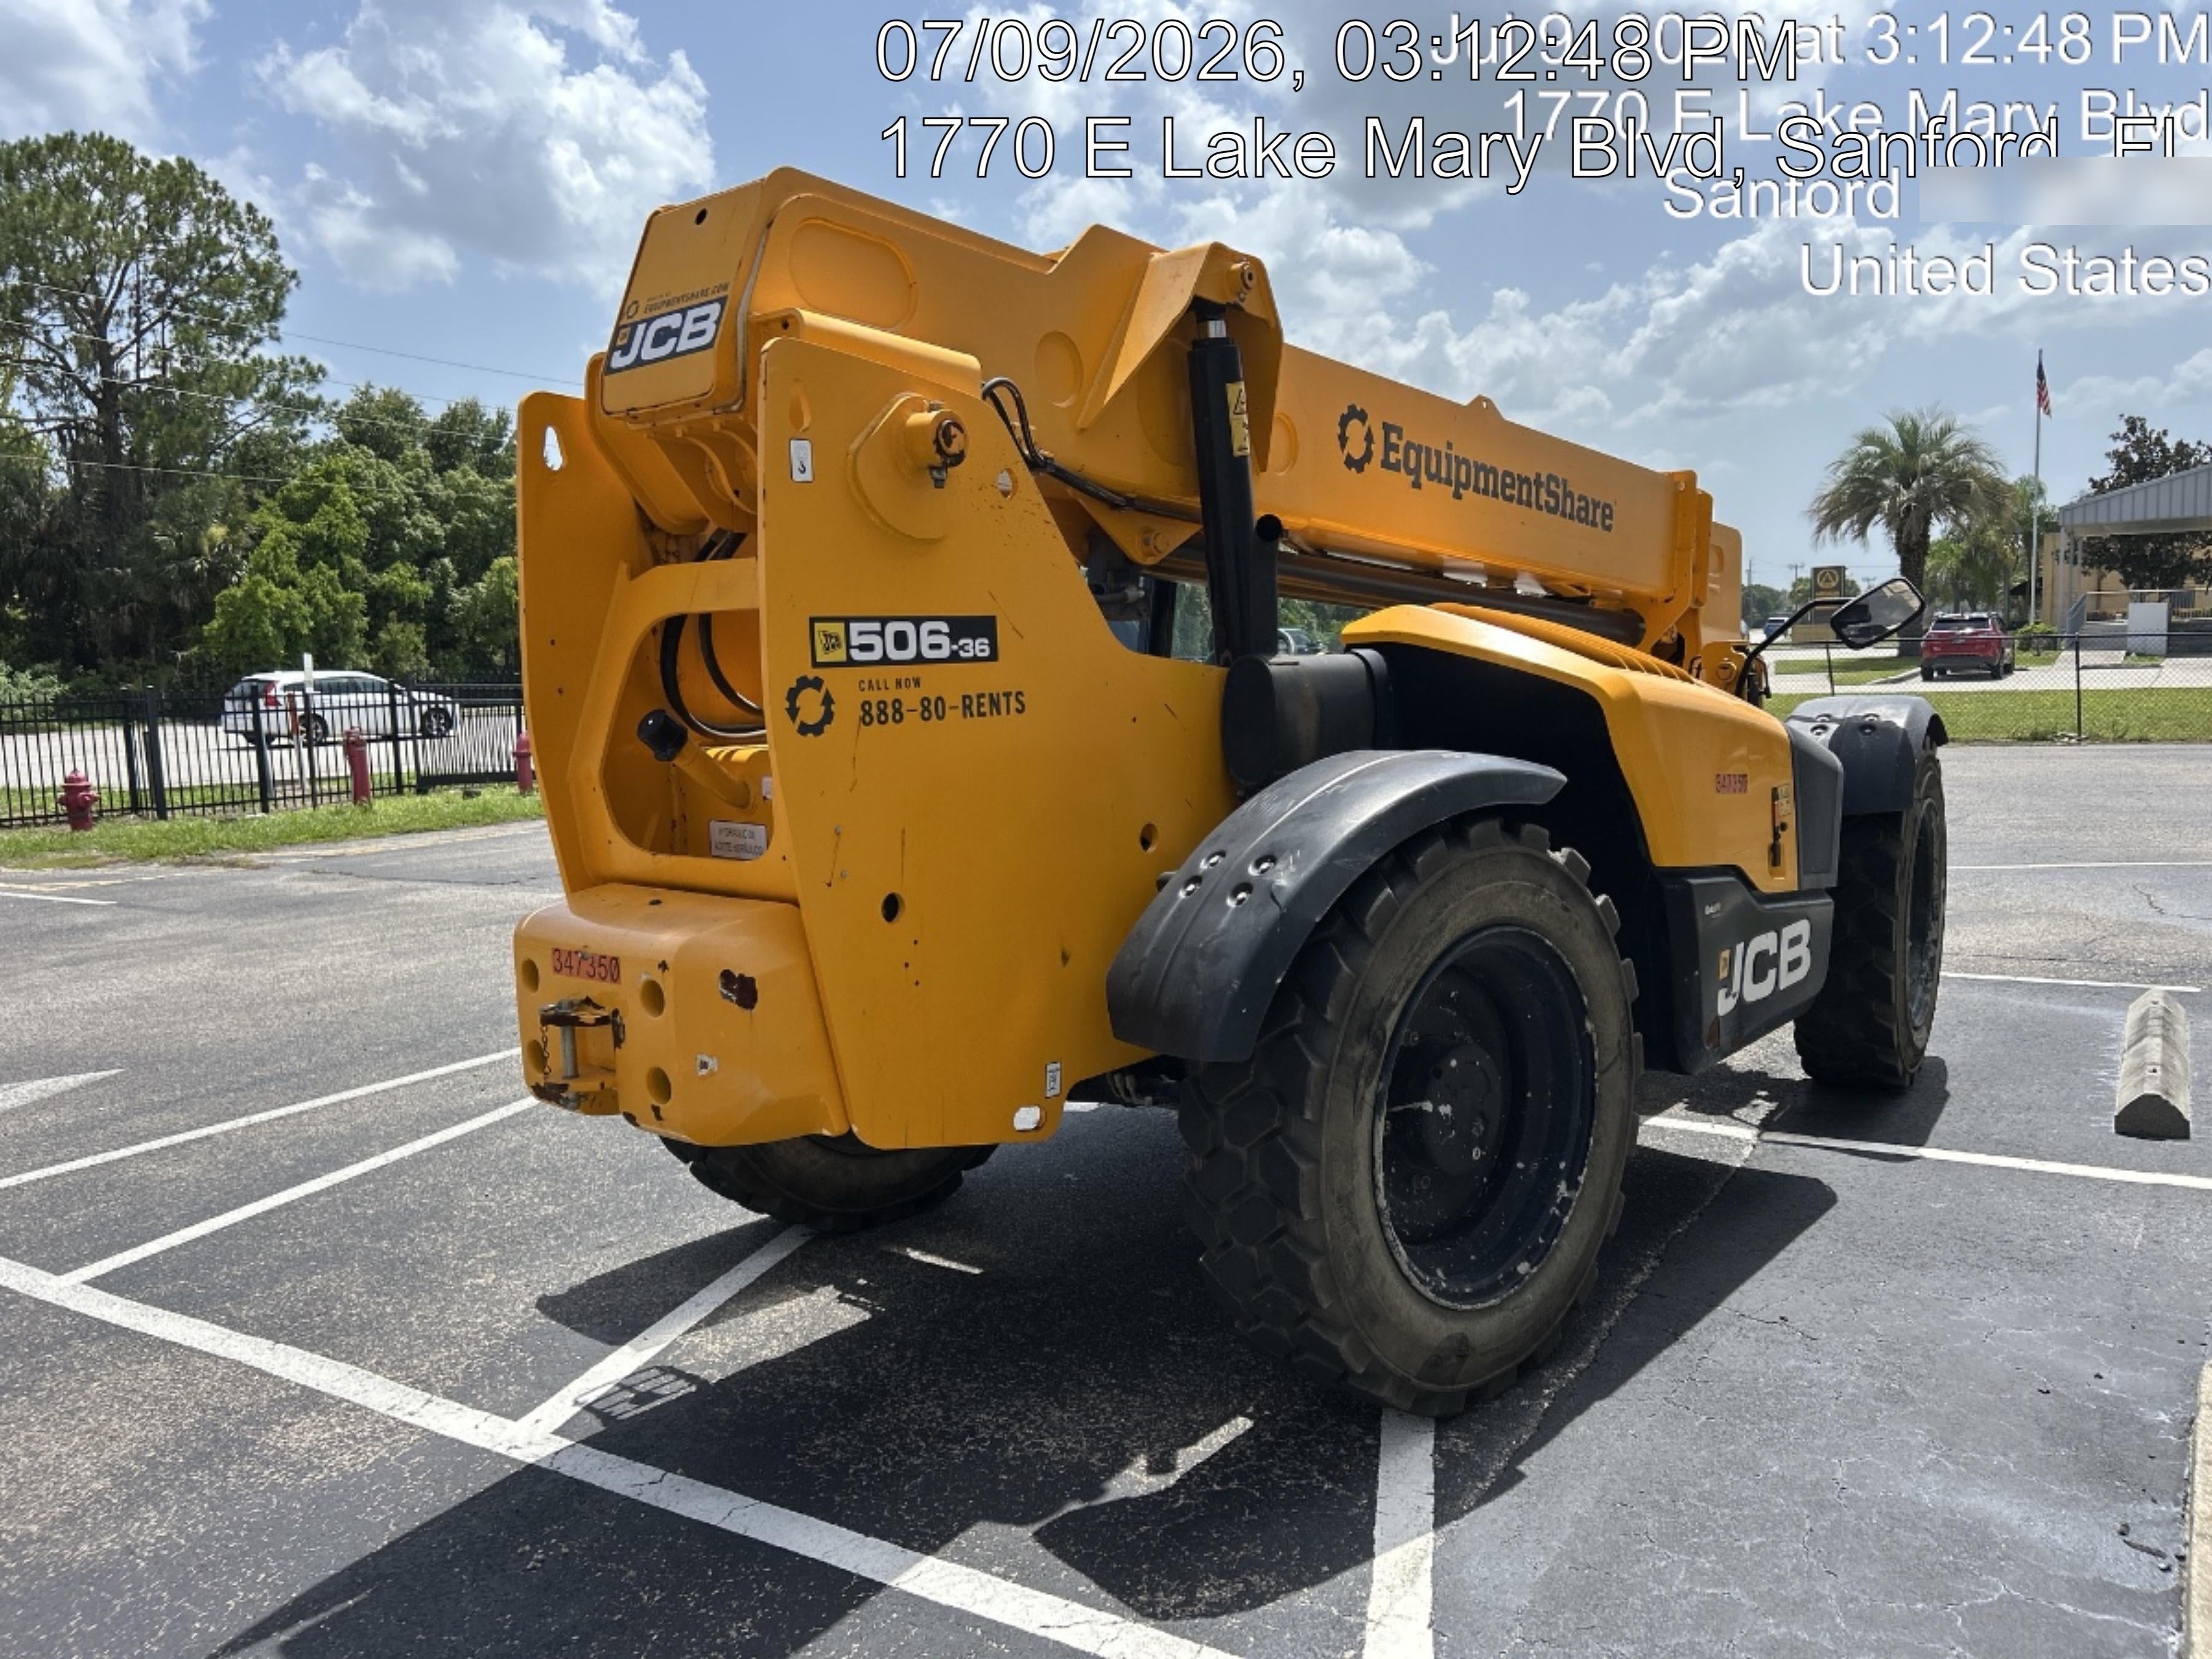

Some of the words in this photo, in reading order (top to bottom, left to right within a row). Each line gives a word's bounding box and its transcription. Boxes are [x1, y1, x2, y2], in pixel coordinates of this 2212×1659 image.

[610, 302, 723, 369] JCB
[1380, 422, 1614, 532] EquipmentShare
[858, 678, 890, 692] CALL
[895, 676, 921, 690] NOW
[860, 691, 1026, 727] 888-80-RENTS
[553, 949, 620, 982] 347350
[1717, 919, 1811, 1016] JCB
